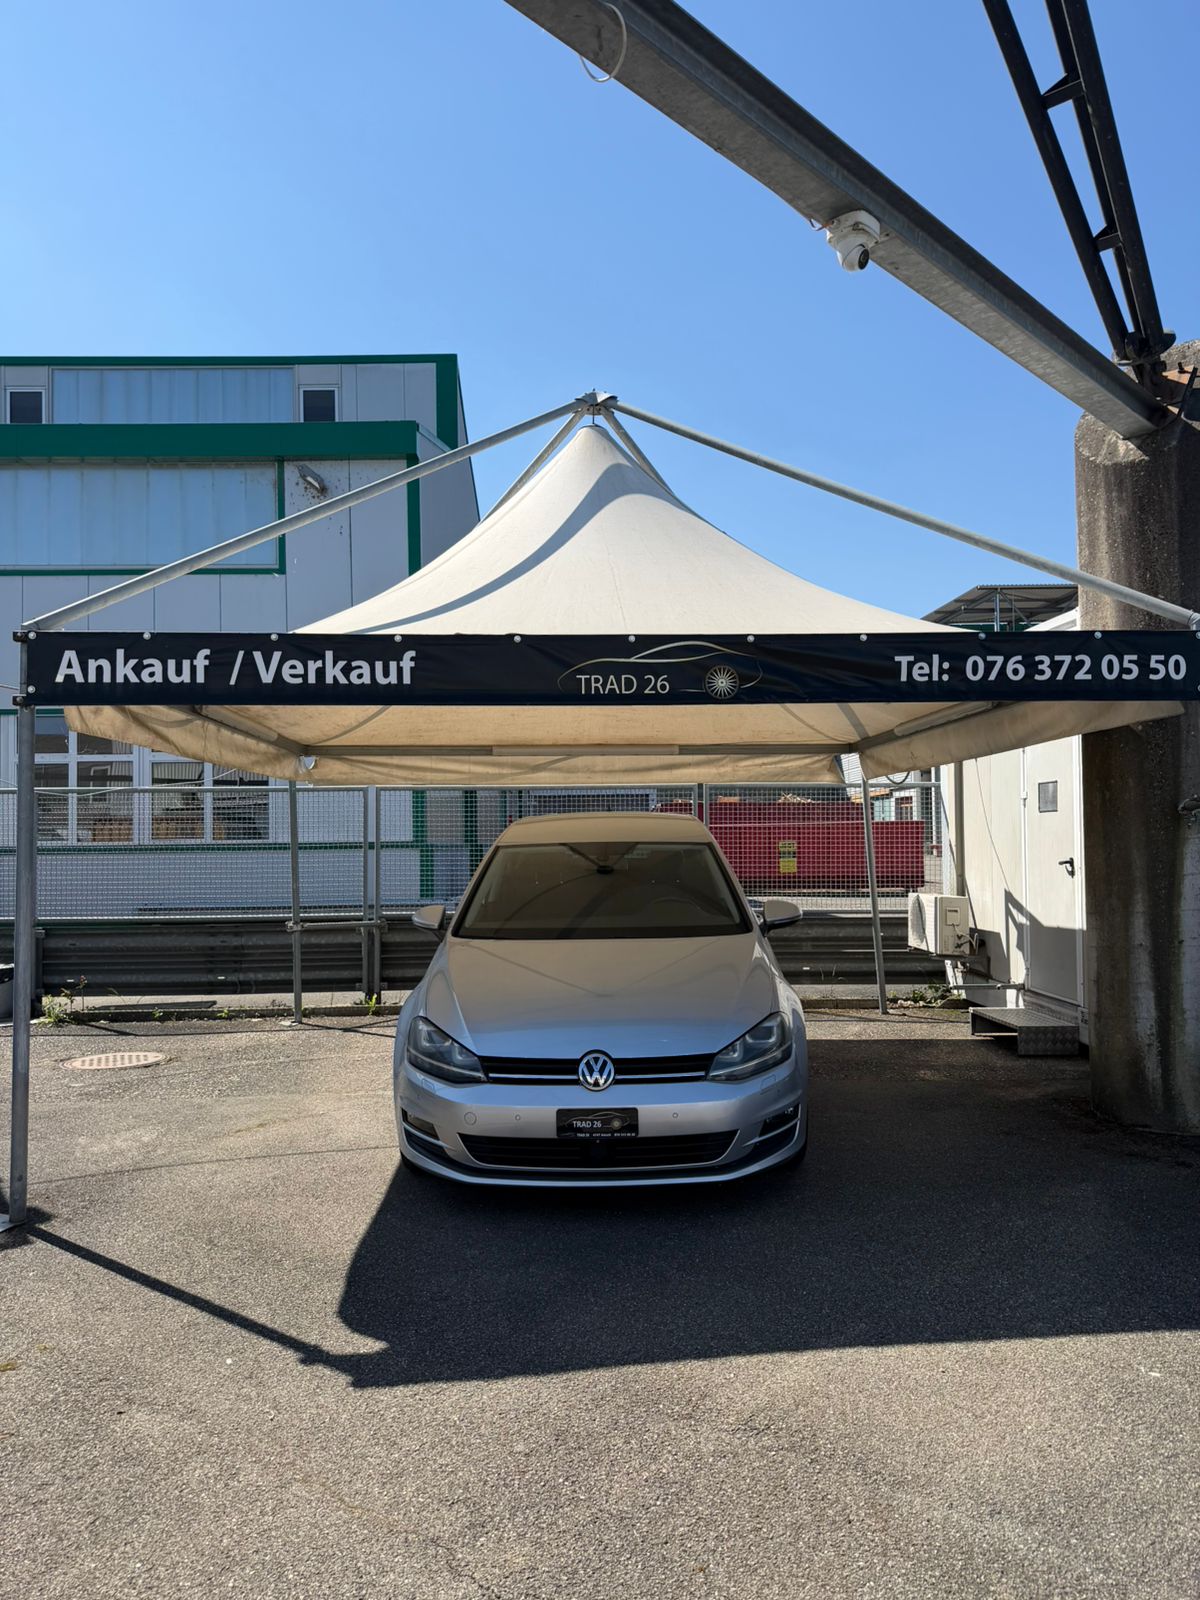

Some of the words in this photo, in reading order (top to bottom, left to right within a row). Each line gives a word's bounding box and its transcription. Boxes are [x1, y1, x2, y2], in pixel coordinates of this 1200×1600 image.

[54, 648, 211, 684] Ankauf
[894, 653, 950, 682] Tel:
[965, 655, 1026, 682] 076
[1034, 654, 1093, 681] 372
[1101, 654, 1140, 681] 05
[1149, 654, 1187, 681] 50
[576, 674, 637, 695] TRAD
[643, 674, 670, 694] 26
[579, 1053, 615, 1090] VW
[572, 1120, 592, 1129] TRAD
[593, 1120, 602, 1128] 26
